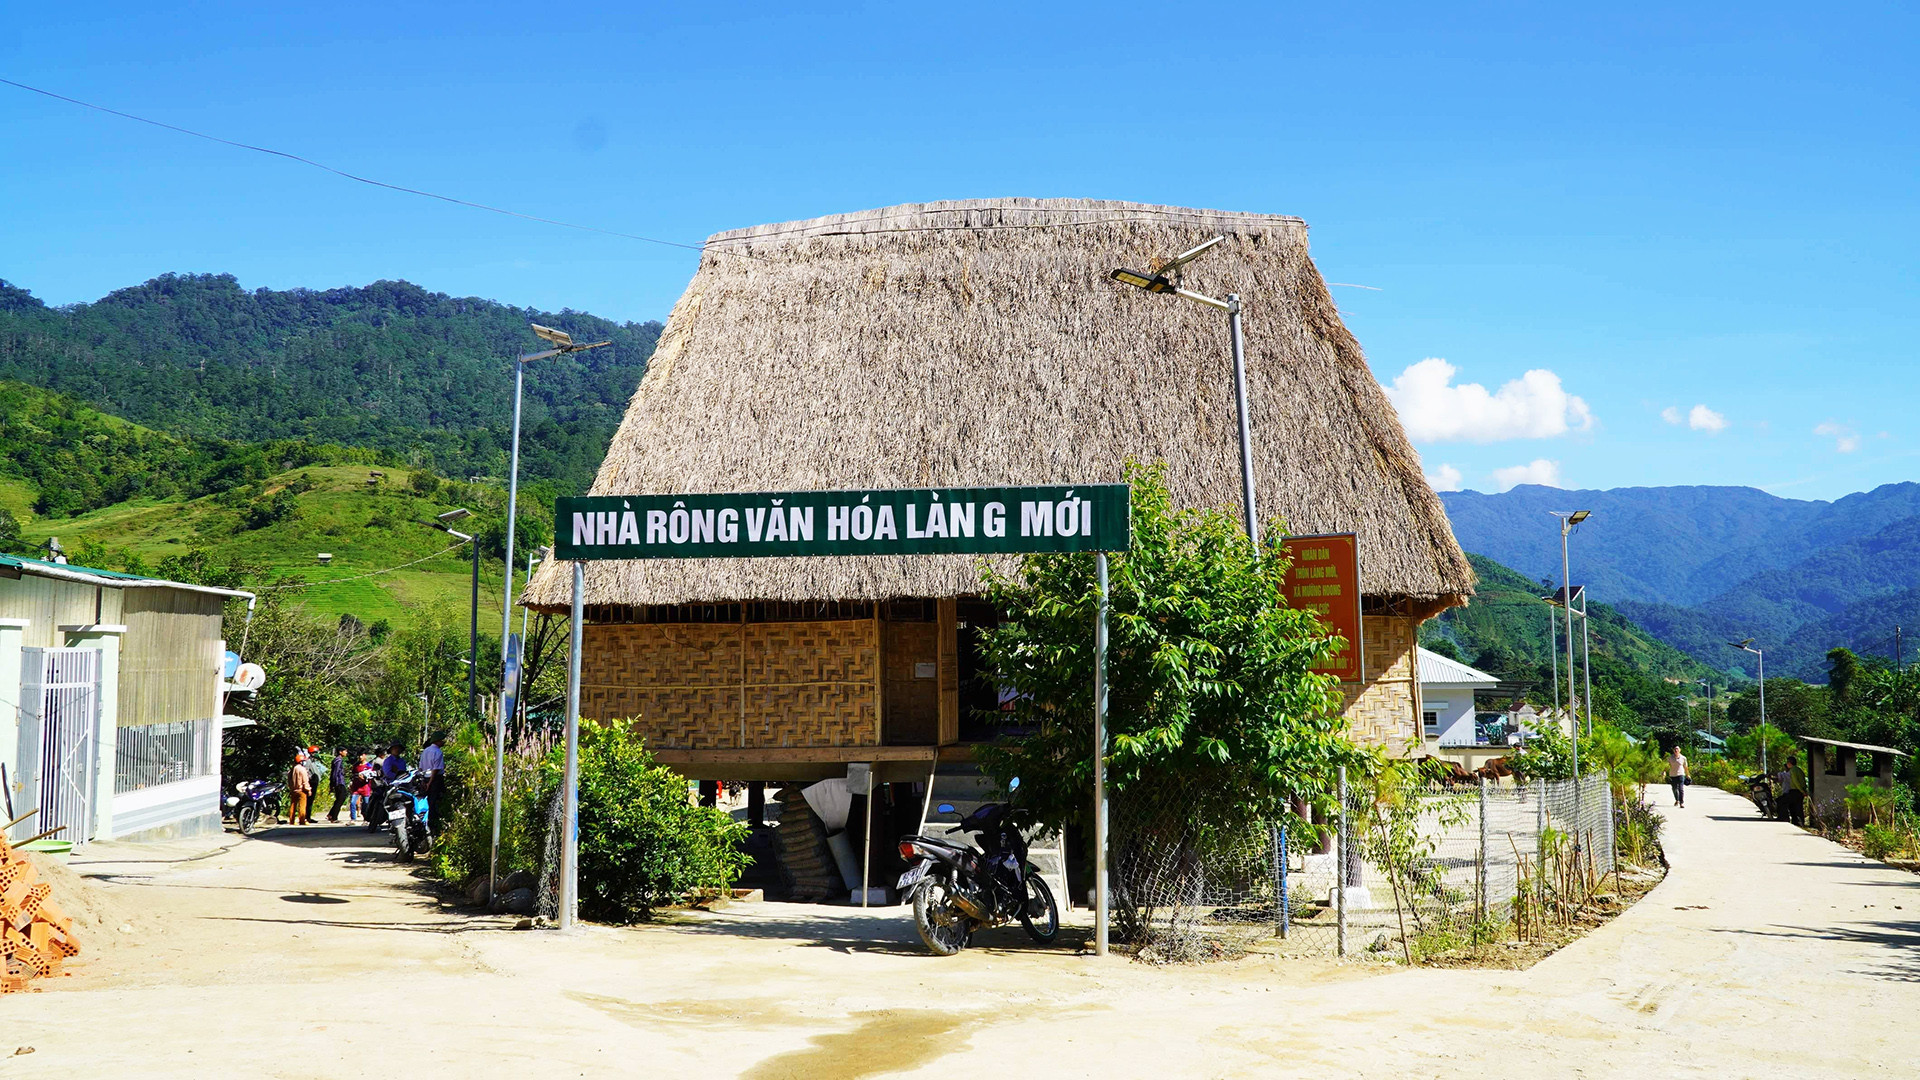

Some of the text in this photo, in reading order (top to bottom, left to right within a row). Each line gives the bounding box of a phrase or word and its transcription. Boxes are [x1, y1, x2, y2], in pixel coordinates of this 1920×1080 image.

[572, 500, 641, 546] NHÀ
[646, 500, 739, 545] RÔNG
[744, 499, 814, 542] VĂN
[827, 494, 898, 541] HÓA
[1020, 489, 1092, 537] MỚI
